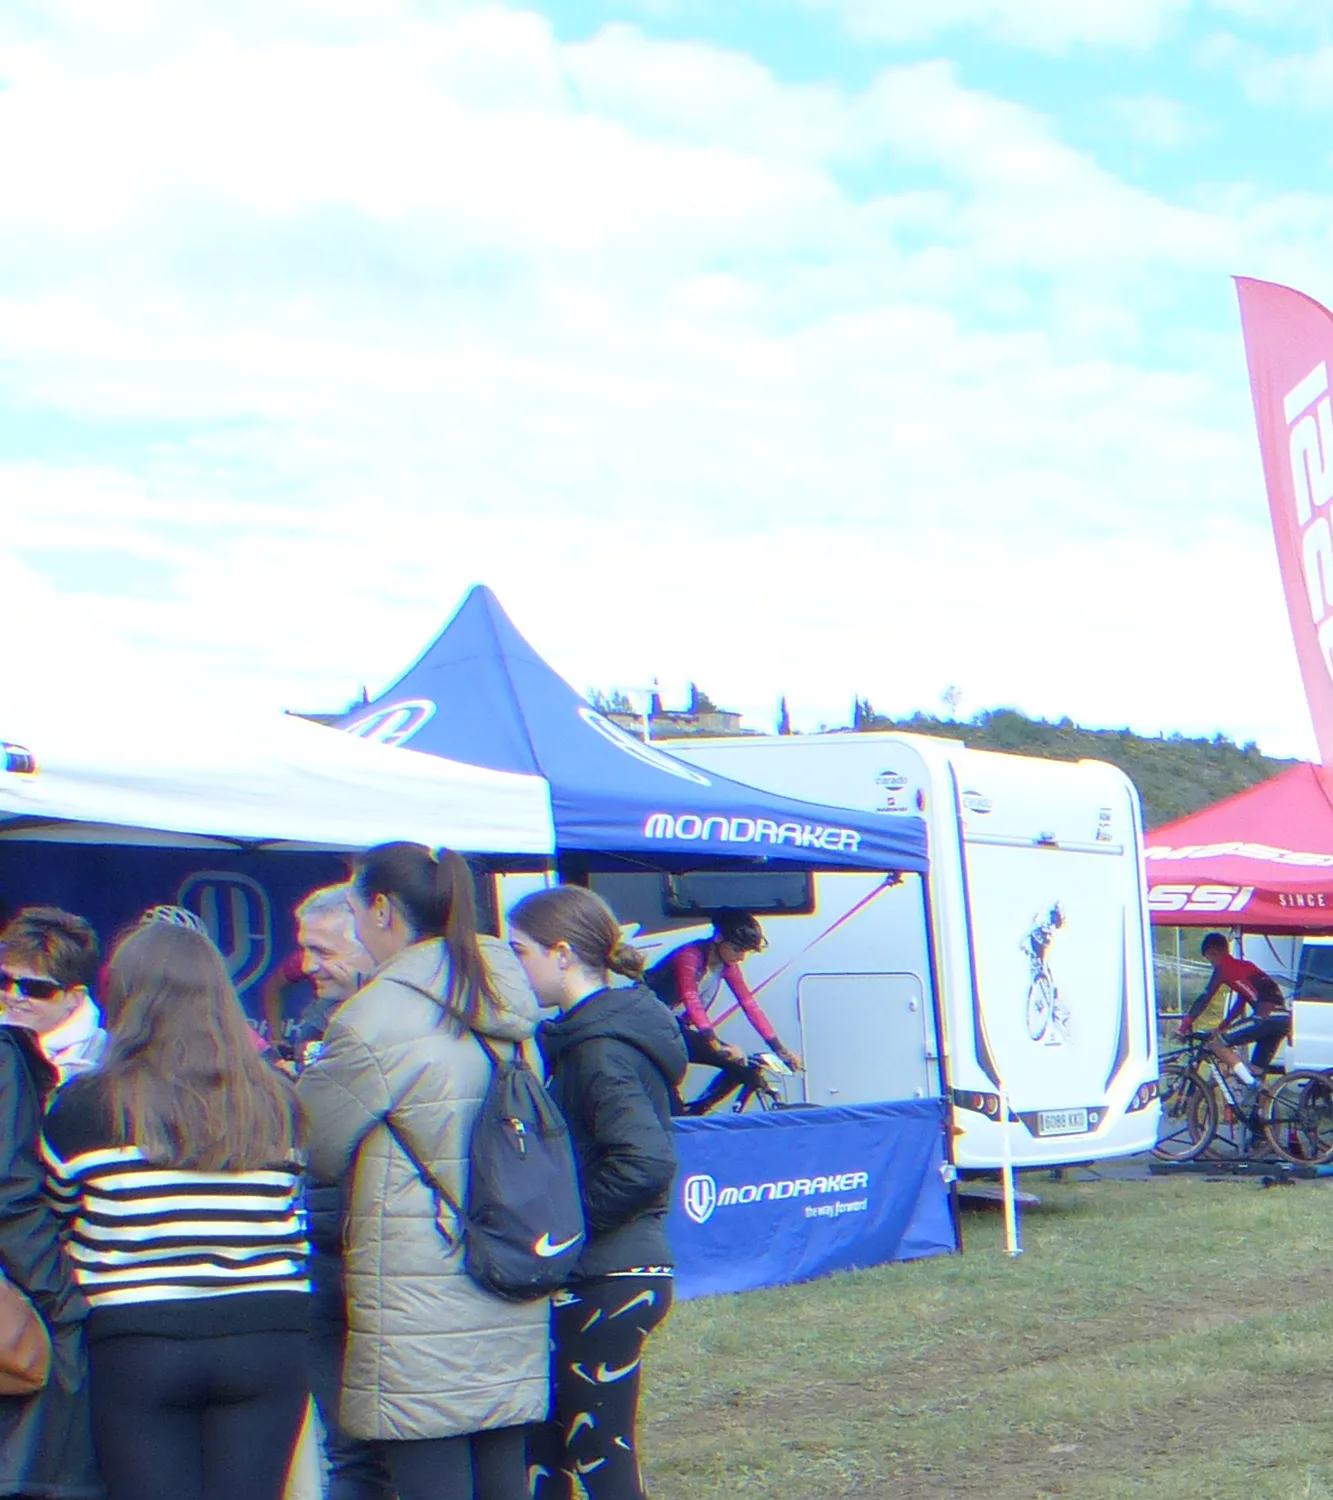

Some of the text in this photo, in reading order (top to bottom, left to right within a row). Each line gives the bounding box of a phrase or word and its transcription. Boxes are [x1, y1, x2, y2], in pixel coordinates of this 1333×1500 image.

[644, 813, 862, 852] MONDRAKER
[1148, 884, 1255, 912] SSI
[1278, 893, 1326, 908] SINCE
[717, 1171, 869, 1207] MONDRAKER
